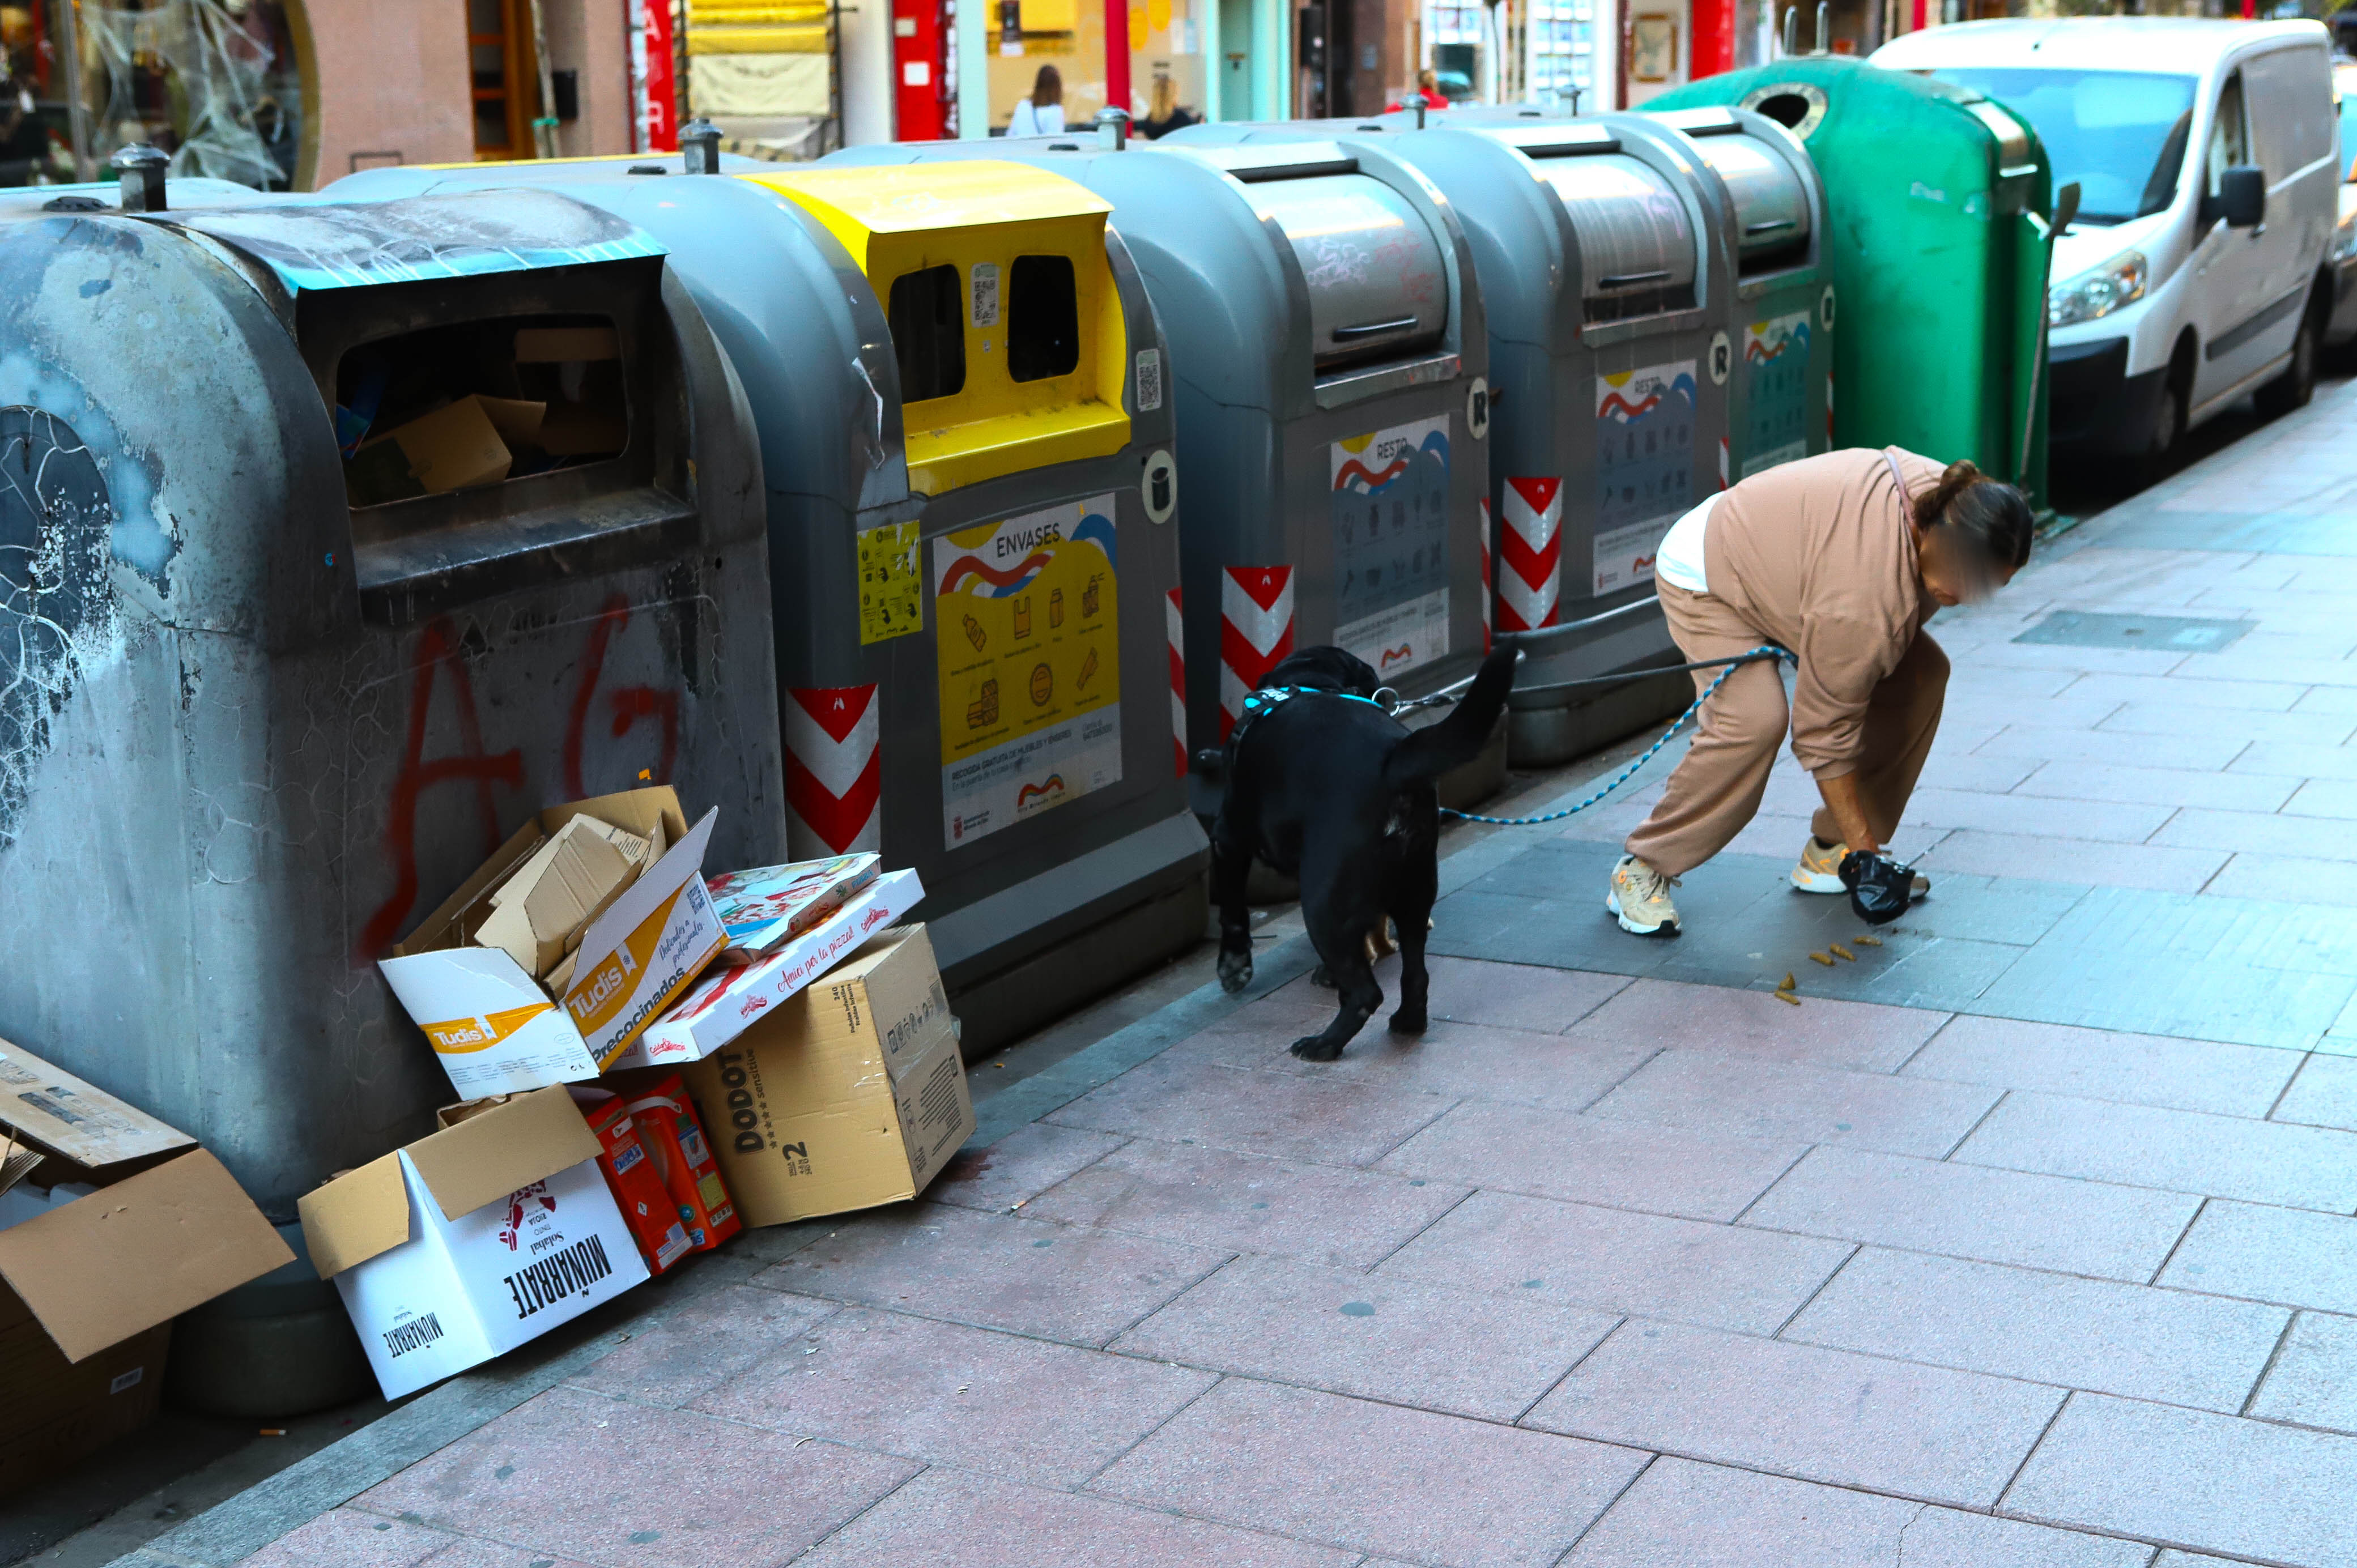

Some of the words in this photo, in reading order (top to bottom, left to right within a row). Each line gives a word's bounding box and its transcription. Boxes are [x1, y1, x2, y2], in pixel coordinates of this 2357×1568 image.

[1716, 346, 1726, 375] R
[1473, 389, 1487, 426] R
[1377, 437, 1407, 460] RESTO
[997, 522, 1061, 558] ENVASES
[778, 964, 804, 992] Amici
[805, 955, 819, 977] per
[818, 948, 828, 960] la
[569, 966, 622, 1019] Tudis
[593, 966, 686, 1062] Precocinados
[433, 1023, 482, 1046] Tudis
[746, 1049, 765, 1098] sensitive
[717, 1050, 765, 1154] DODOT
[782, 1141, 807, 1161] 2
[530, 1231, 564, 1255] Solabal
[503, 1233, 612, 1319] MUÑARRATE
[382, 1311, 444, 1358] MUÑARRATE
